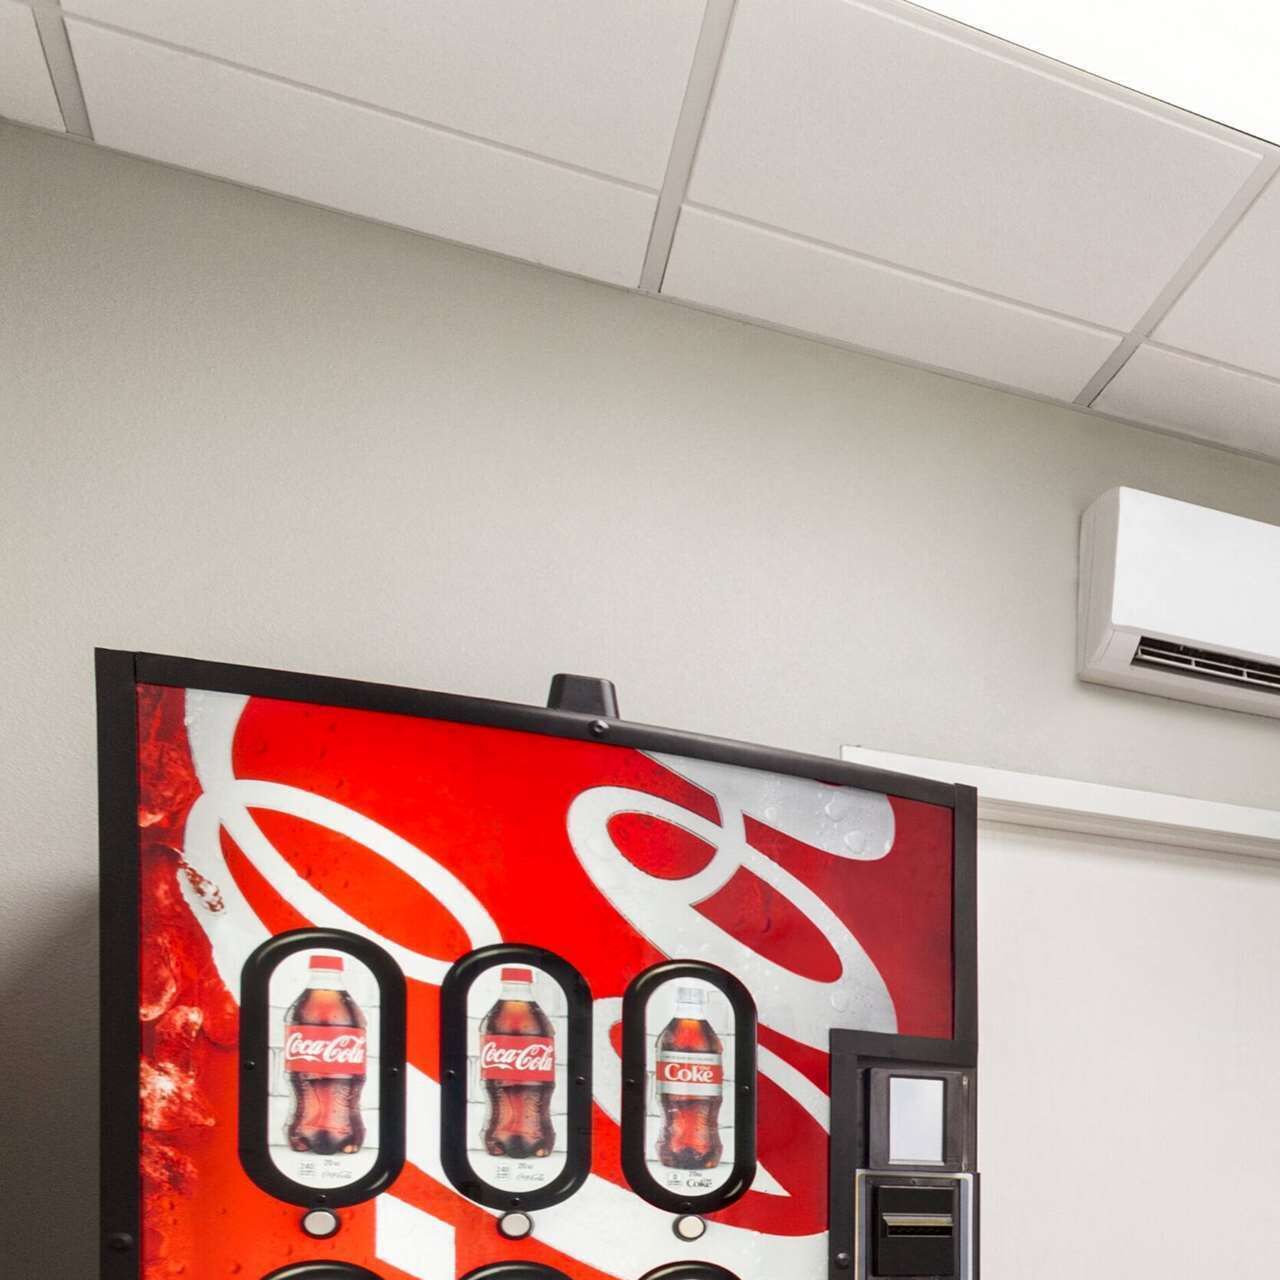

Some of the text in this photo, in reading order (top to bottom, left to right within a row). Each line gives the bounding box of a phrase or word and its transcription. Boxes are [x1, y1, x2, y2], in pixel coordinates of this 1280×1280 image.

[285, 1031, 365, 1064] Coca-Cola
[481, 1041, 554, 1072] Coca-Cola
[664, 1063, 713, 1083] Coke
